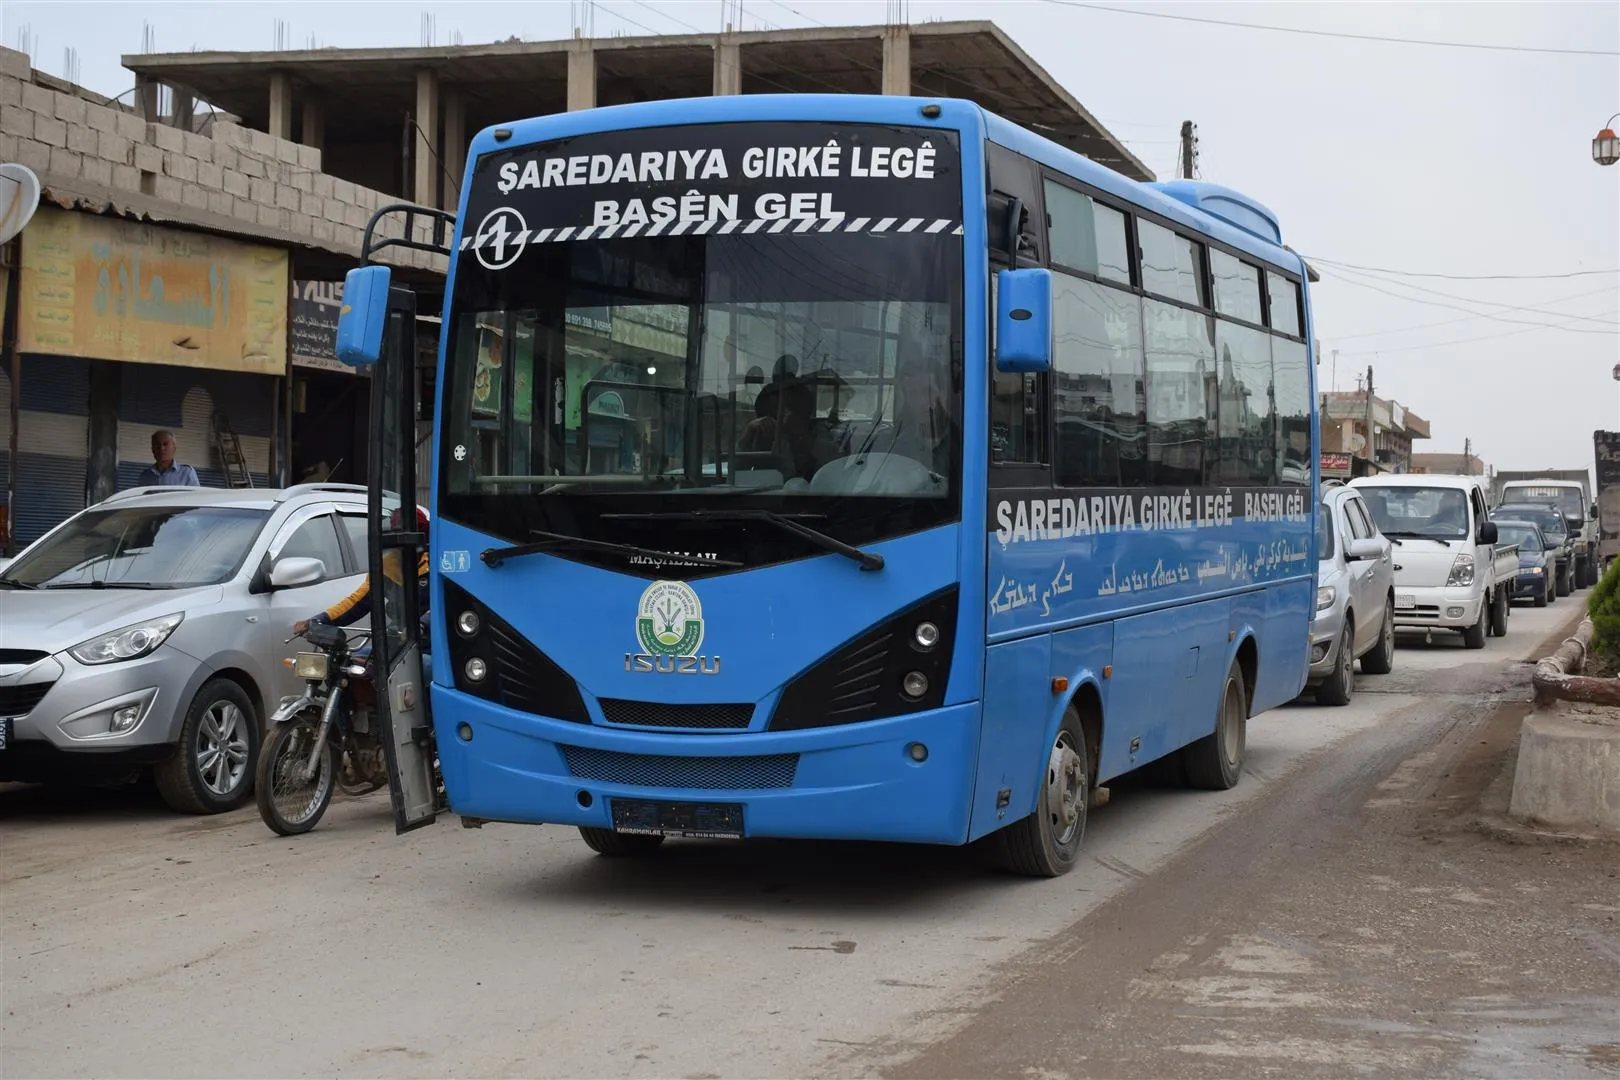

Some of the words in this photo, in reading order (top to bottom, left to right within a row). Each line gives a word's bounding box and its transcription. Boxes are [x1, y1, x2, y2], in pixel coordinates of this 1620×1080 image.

[498, 147, 729, 194] ŞAREDARIYA
[742, 139, 842, 179] GIRKÊ
[851, 141, 936, 179] LEGÊ
[593, 190, 738, 228] BASÊN
[755, 192, 845, 221] GEL
[92, 241, 230, 330] السعادة
[996, 496, 1136, 550] ŞAREDARIYA
[1140, 489, 1192, 532] GIRKÊ
[1196, 488, 1233, 528] LEGÊ
[624, 652, 721, 675] ISUZU
